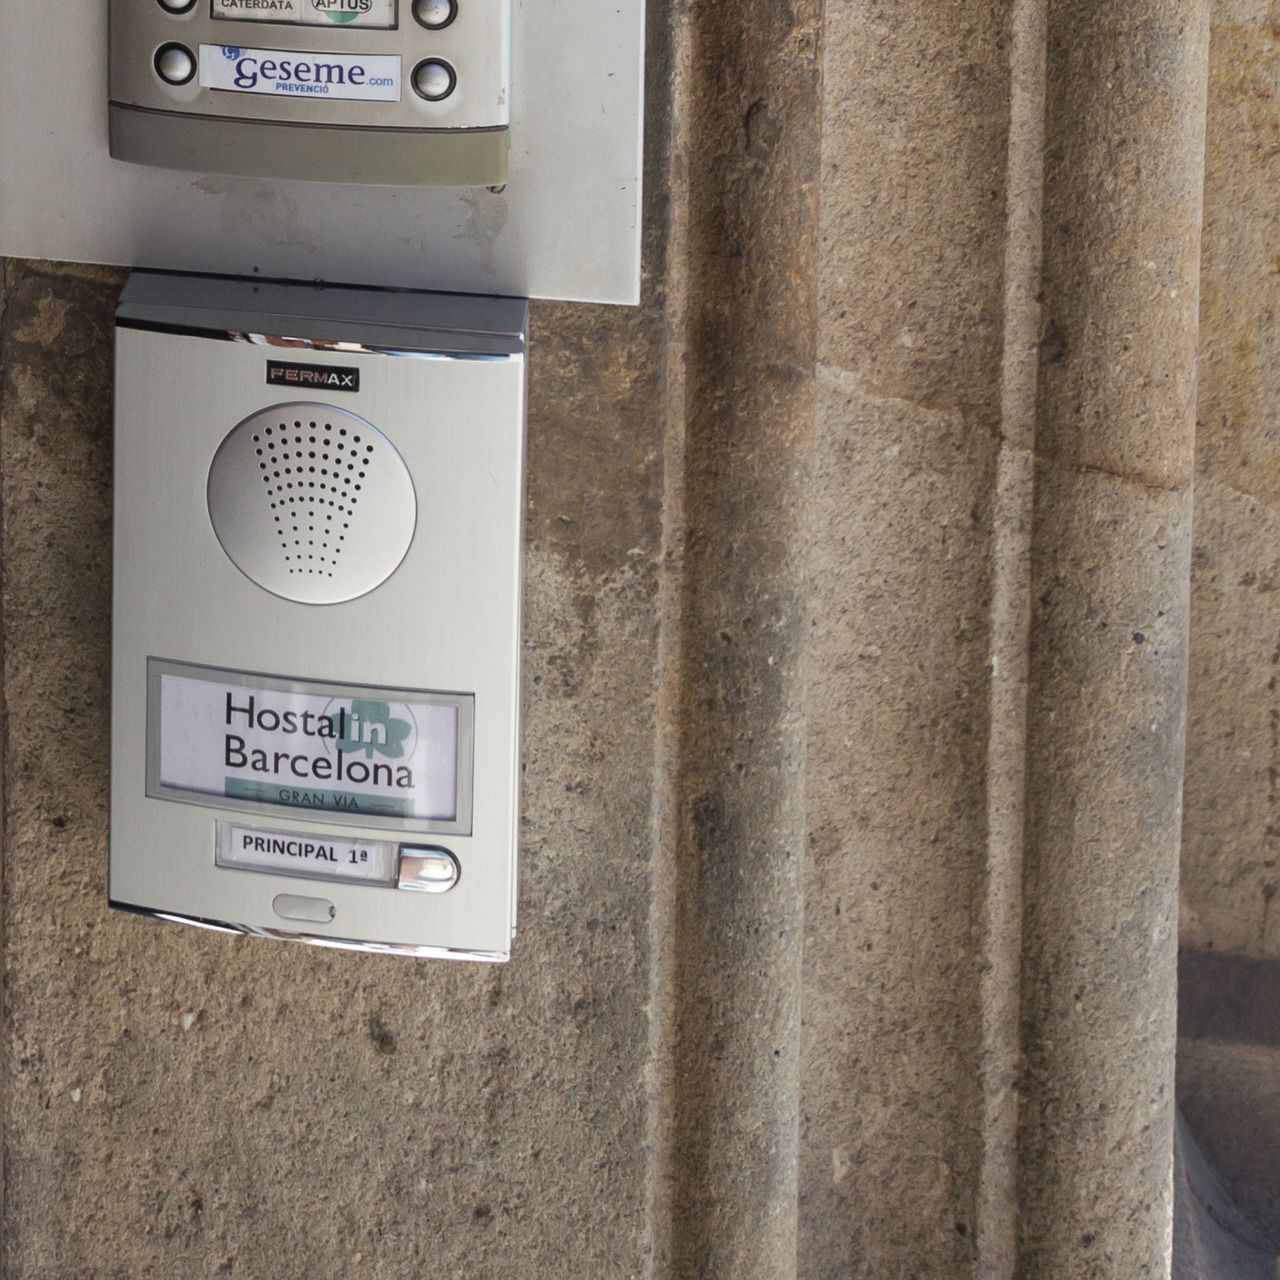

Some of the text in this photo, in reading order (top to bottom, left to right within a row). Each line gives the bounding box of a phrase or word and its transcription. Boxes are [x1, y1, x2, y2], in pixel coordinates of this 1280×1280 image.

[276, 82, 329, 94] PREVENCIÓ
[270, 367, 353, 387] FERMAX
[224, 733, 415, 789] Barcelona
[278, 787, 358, 810] GRAN VIA
[242, 834, 368, 864] PRINCIPAL 1ª
